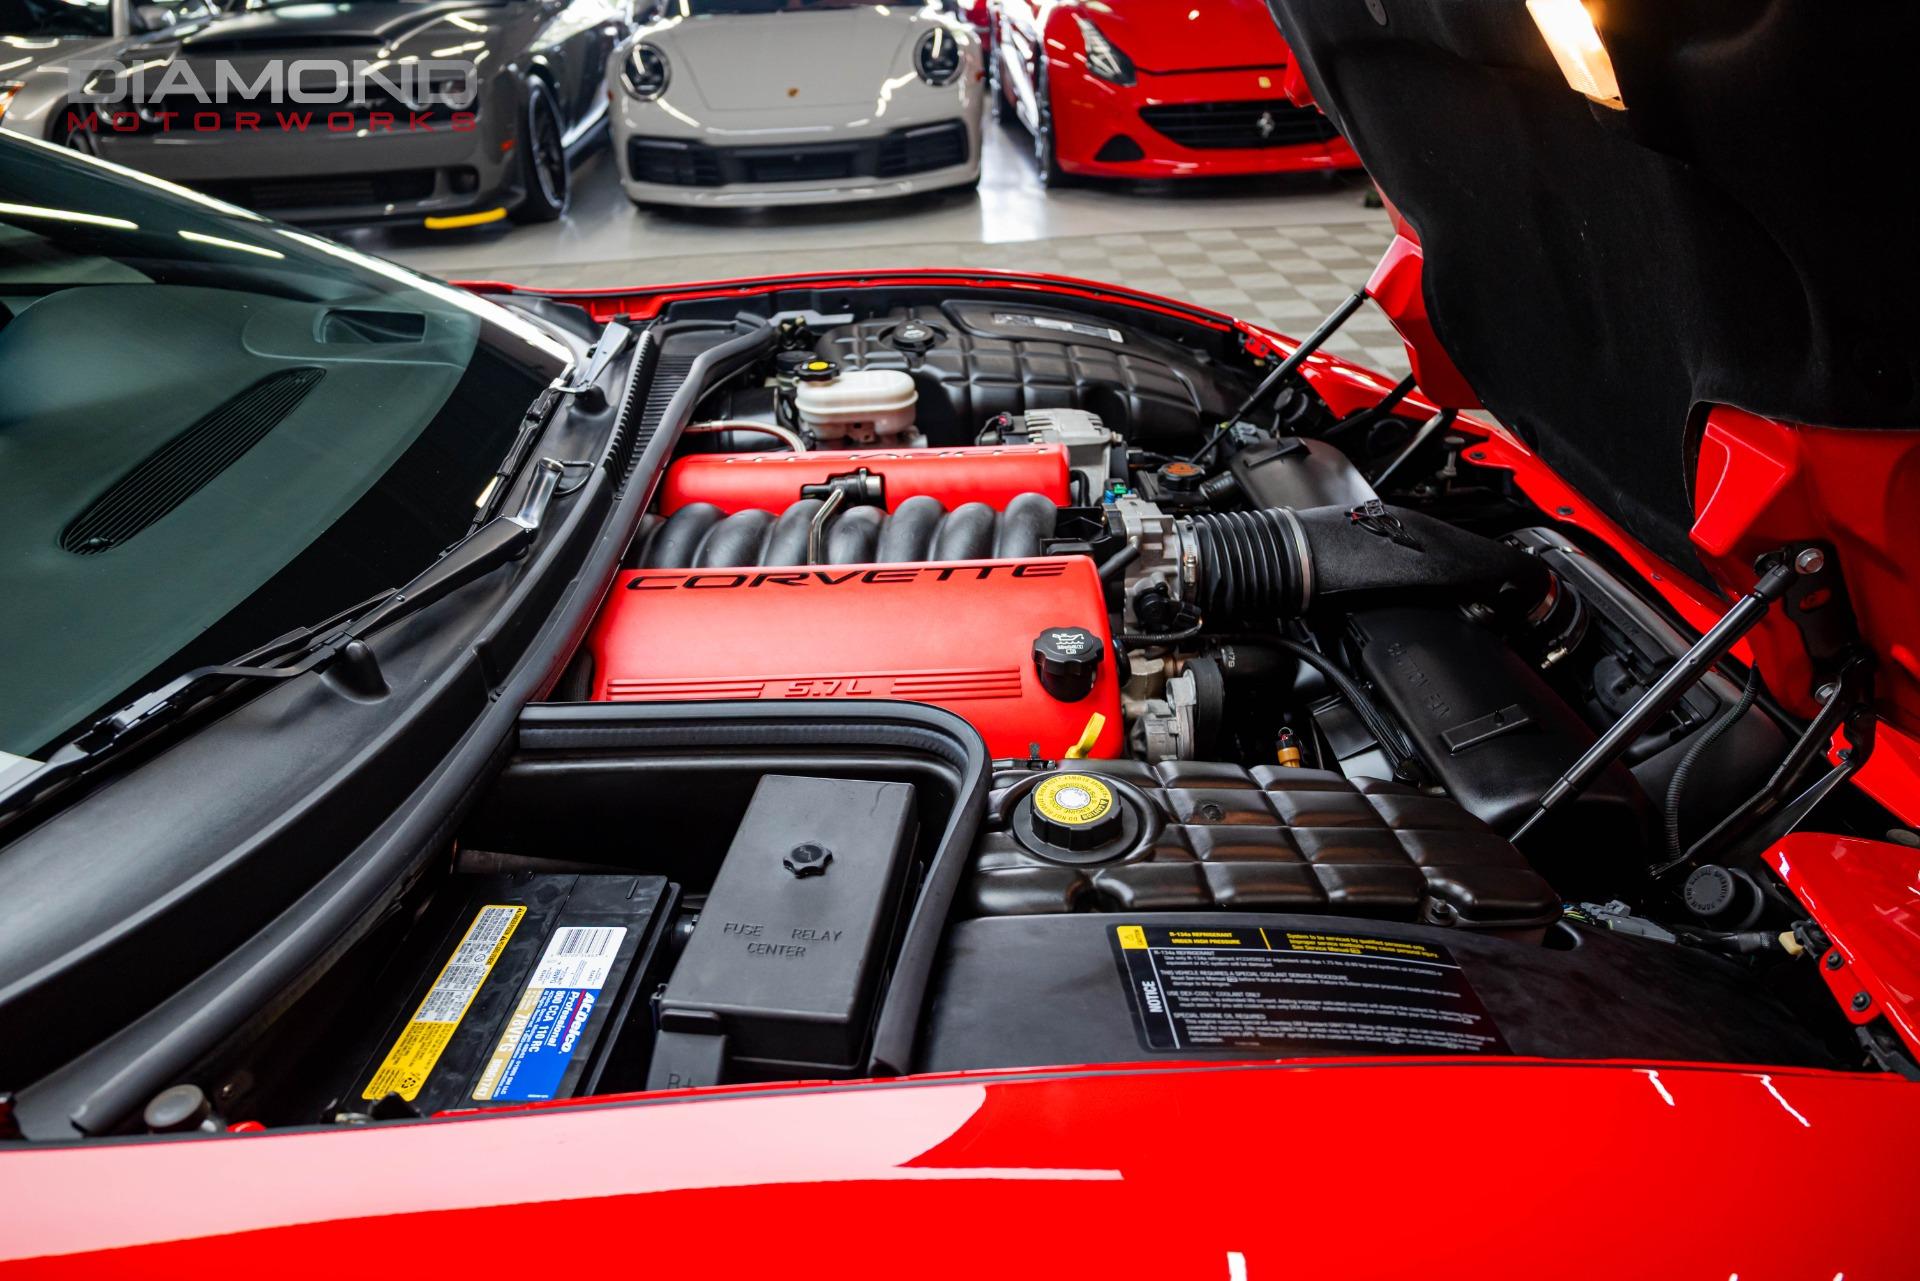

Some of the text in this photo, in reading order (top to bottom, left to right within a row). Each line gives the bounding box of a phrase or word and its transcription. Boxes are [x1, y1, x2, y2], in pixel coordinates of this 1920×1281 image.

[625, 562, 1069, 591] CORVETTE
[784, 677, 873, 698] 5.7L
[723, 922, 843, 943] FUSE RELAY
[747, 942, 806, 958] CENTER
[552, 990, 566, 1004] 800
[1142, 981, 1163, 1013] NOTICE
[543, 1005, 559, 1022] CCA
[547, 991, 580, 1047] Professional
[561, 991, 595, 1053] ACDelco
[536, 1025, 550, 1039] 110
[528, 1040, 543, 1053] RC
